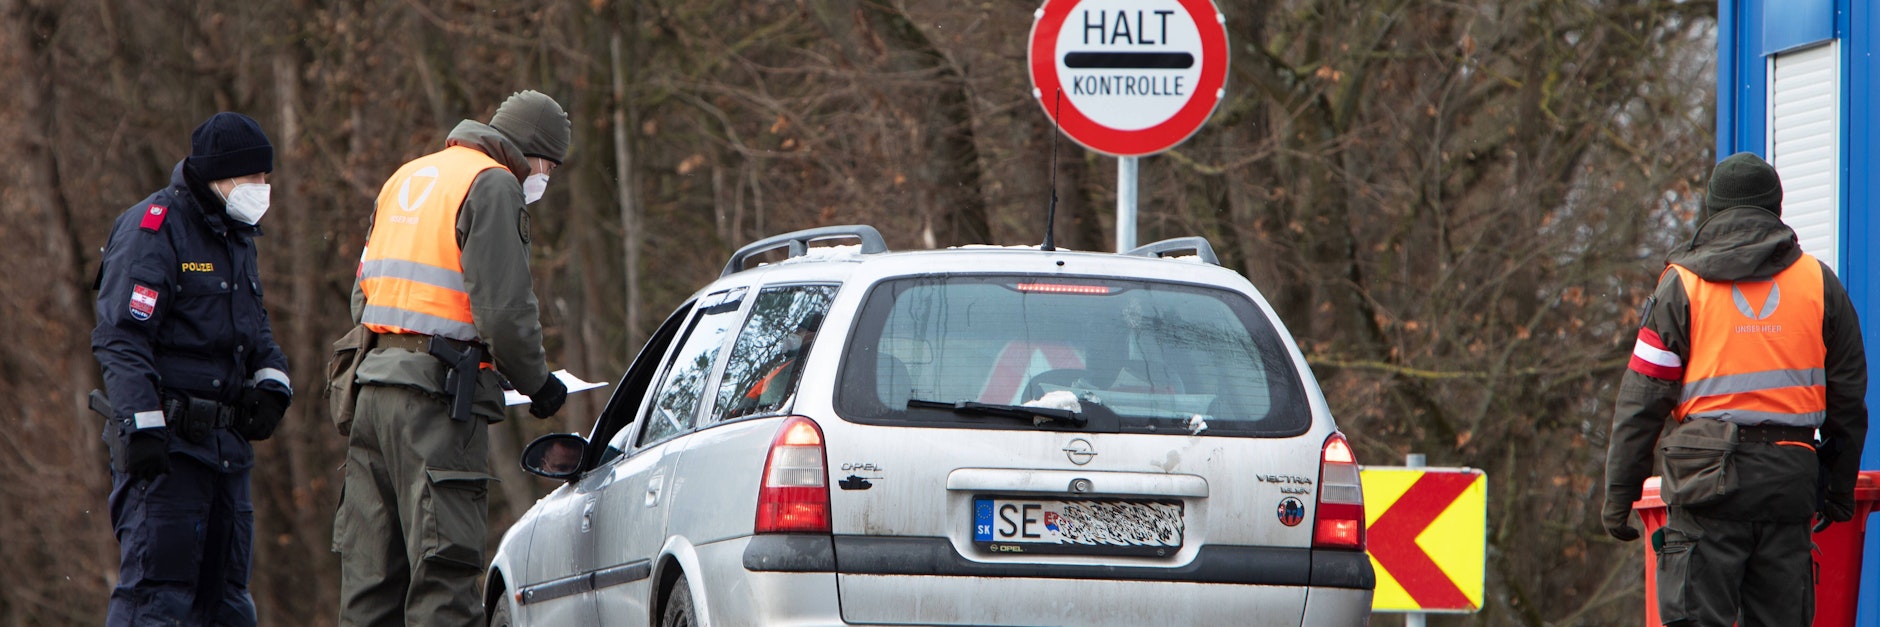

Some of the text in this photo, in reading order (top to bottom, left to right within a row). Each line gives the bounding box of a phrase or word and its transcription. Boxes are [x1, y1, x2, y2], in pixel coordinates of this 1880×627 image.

[1083, 10, 1174, 45] HALT
[1073, 75, 1184, 96] KONTROLLE
[1761, 325, 1782, 333] HEER
[841, 463, 882, 472] OPEL
[1256, 474, 1312, 485] VECTRA
[999, 504, 1042, 538] SE
[977, 525, 991, 535] SK
